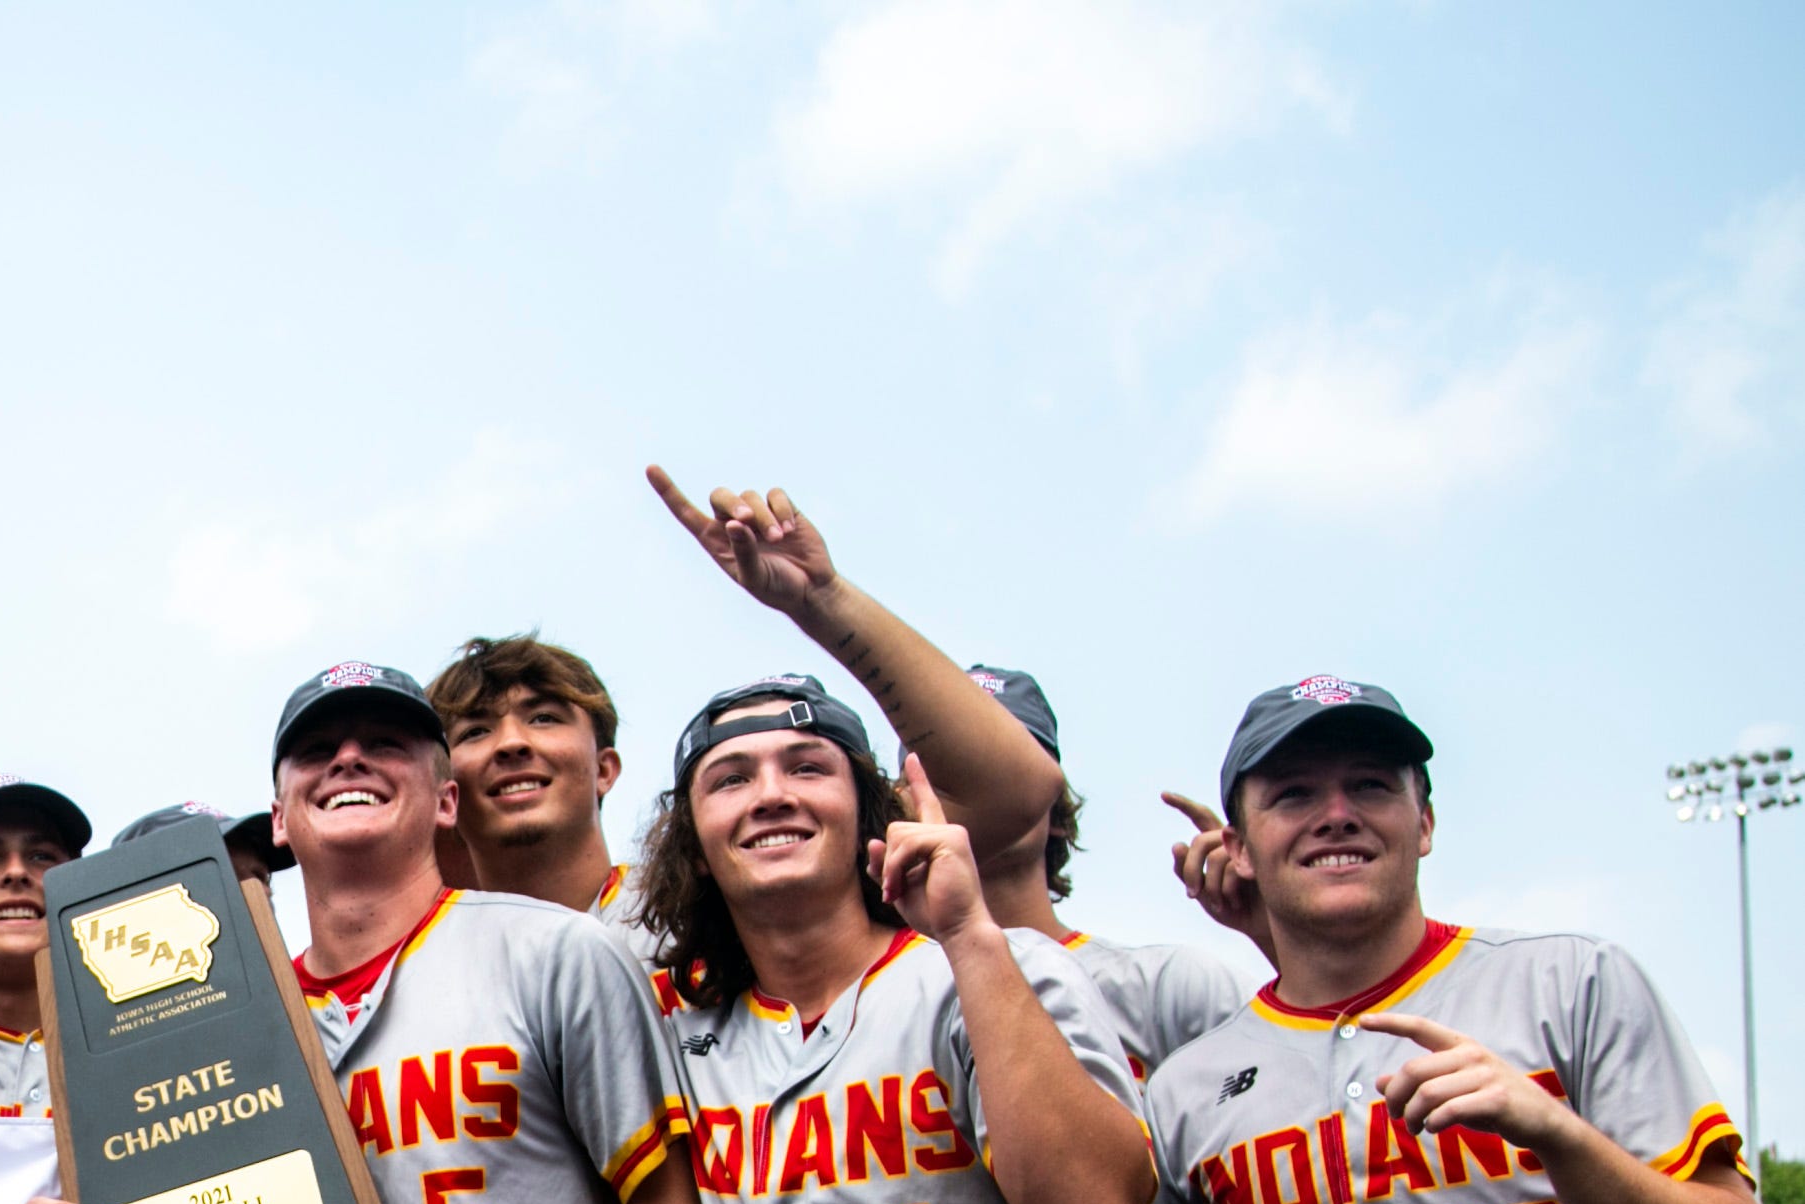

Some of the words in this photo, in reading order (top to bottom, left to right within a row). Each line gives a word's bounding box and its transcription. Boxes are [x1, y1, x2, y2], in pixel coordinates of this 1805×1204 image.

[321, 665, 383, 688] CHAMPION
[89, 919, 199, 974] IHSAA
[109, 1013, 157, 1037] ATHLETIC
[158, 990, 228, 1021] ASSOCIATION
[115, 1006, 145, 1023] IOWA
[146, 997, 173, 1013] HIGH
[174, 983, 214, 1004] SCHOOL
[133, 1059, 236, 1113] STATE
[102, 1083, 285, 1161] CHAMPION
